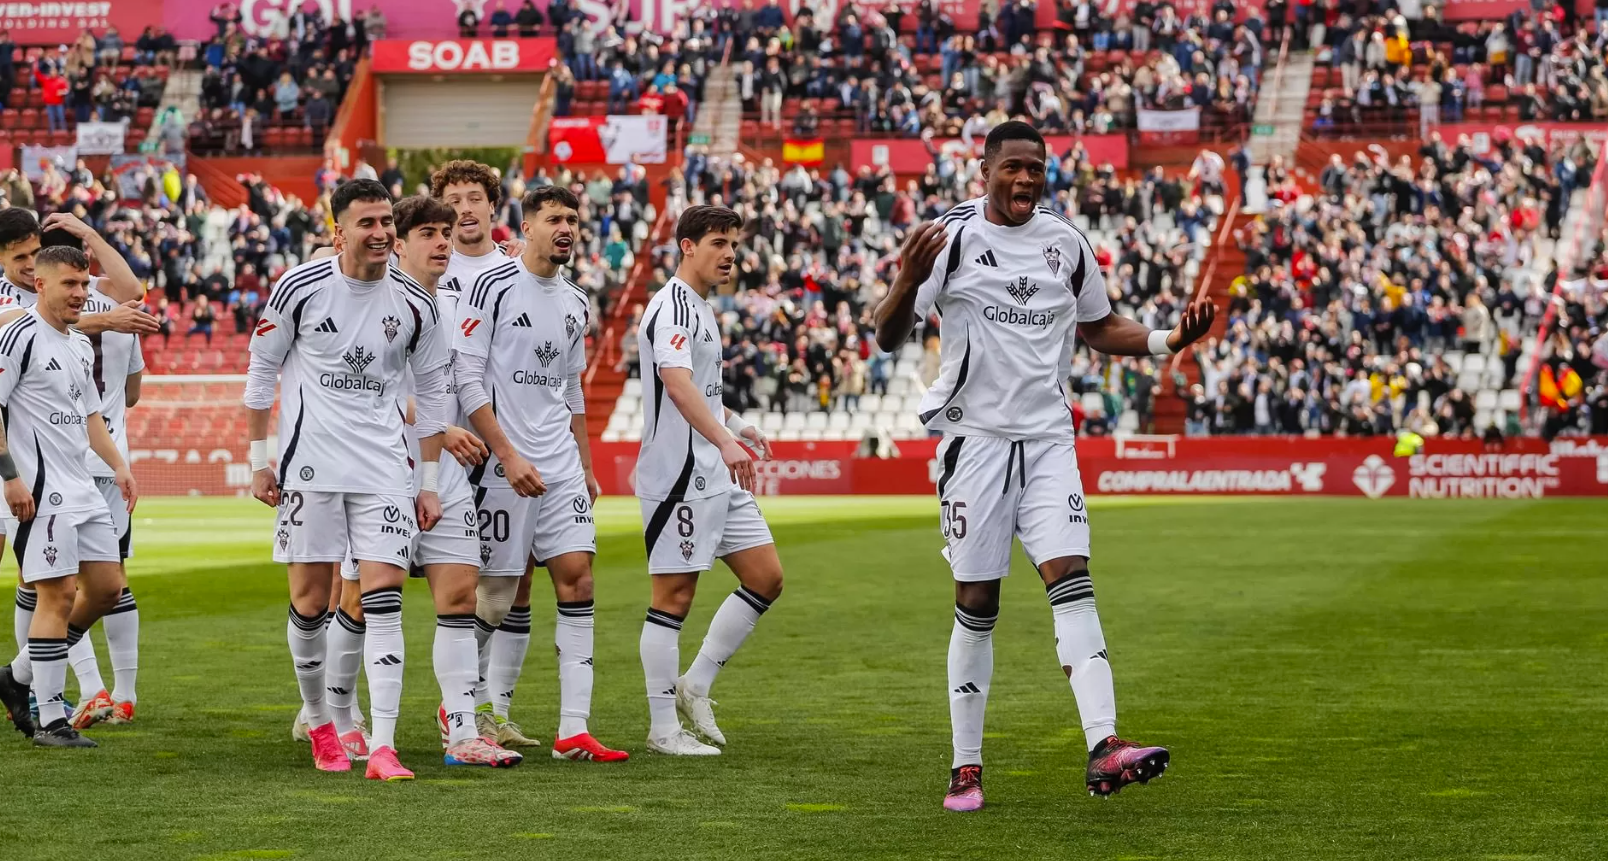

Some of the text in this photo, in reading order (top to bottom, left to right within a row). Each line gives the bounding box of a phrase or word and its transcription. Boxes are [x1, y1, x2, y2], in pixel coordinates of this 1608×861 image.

[0, 18, 70, 29] OLDING
[408, 40, 520, 70] SOAB
[983, 305, 1055, 330] Globalcaja
[319, 373, 386, 397] Globalcaj
[512, 369, 562, 392] Globalcaja
[1408, 453, 1560, 476] SCIENTIFFIC
[1097, 470, 1292, 491] COMPRALAENTRADA
[280, 491, 304, 526] 22
[477, 508, 510, 542] 20
[677, 505, 695, 538] 8
